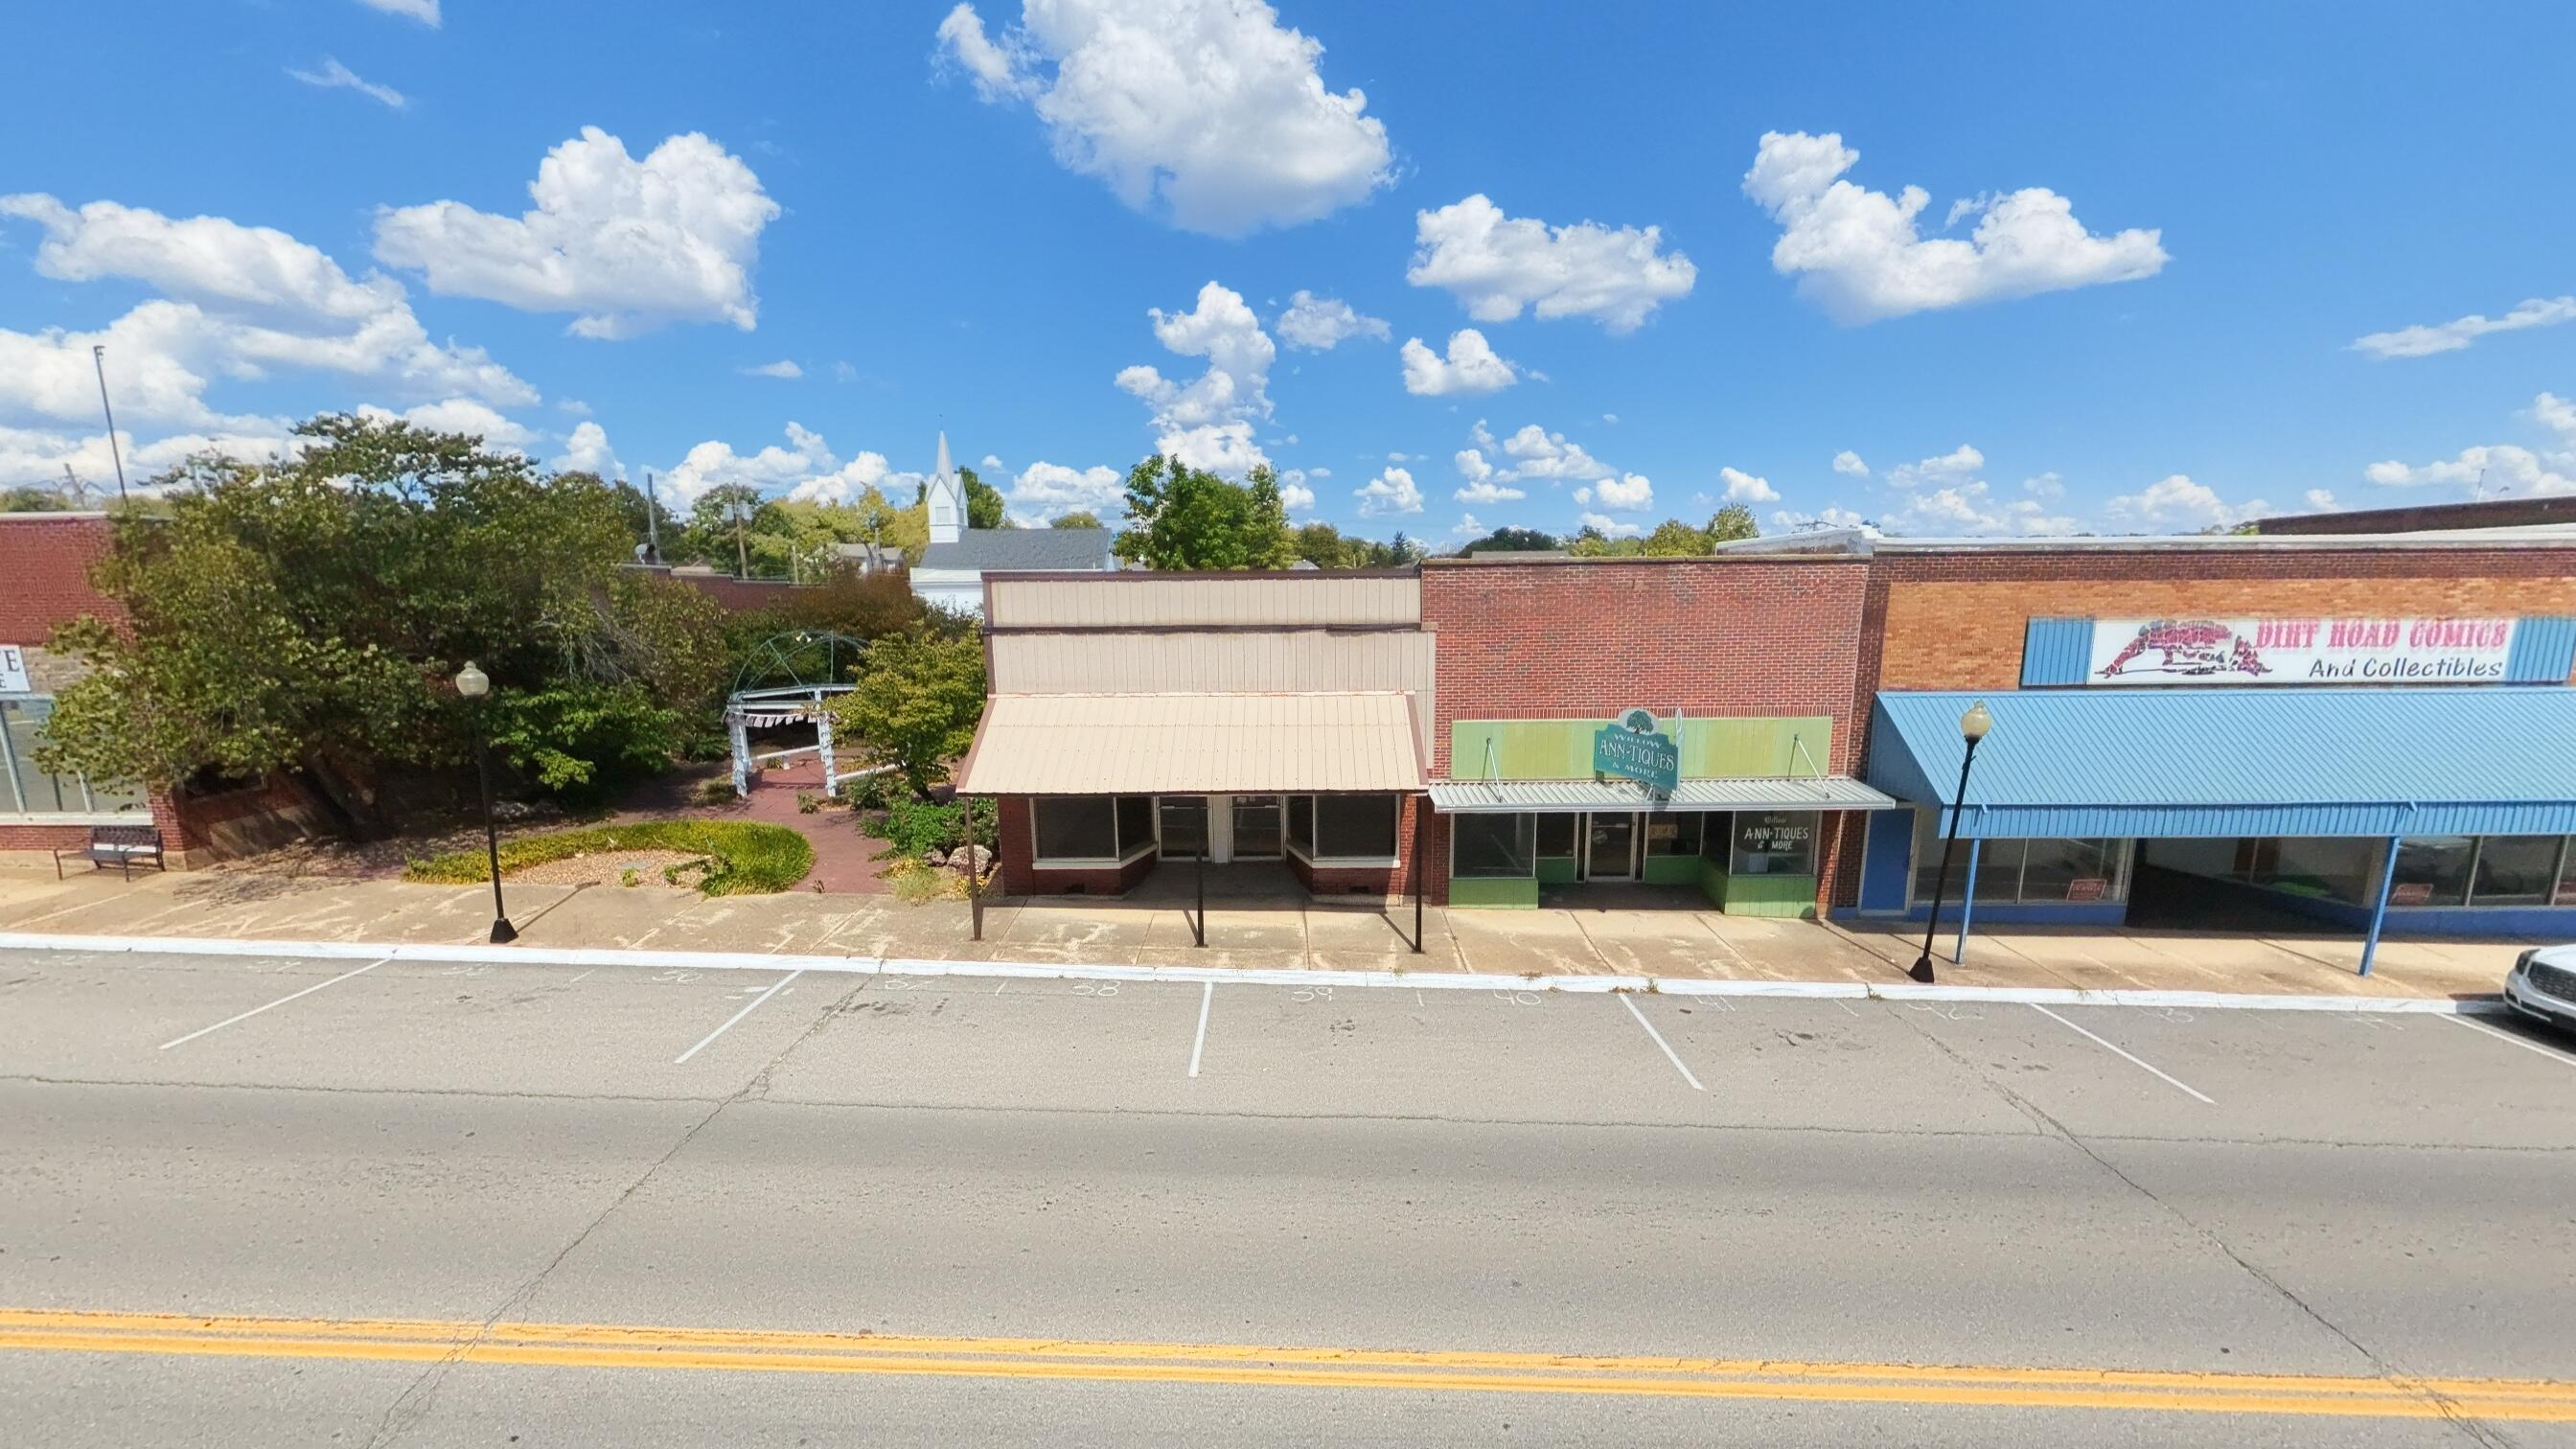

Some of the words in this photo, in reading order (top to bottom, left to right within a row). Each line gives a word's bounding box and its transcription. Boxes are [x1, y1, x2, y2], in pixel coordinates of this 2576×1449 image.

[2408, 619, 2508, 649] COMICS
[2309, 658, 2356, 678] And
[2362, 656, 2503, 678] Collectibles
[1599, 739, 1674, 771] ANN-TIQUES
[1771, 840, 1793, 851] MORE
